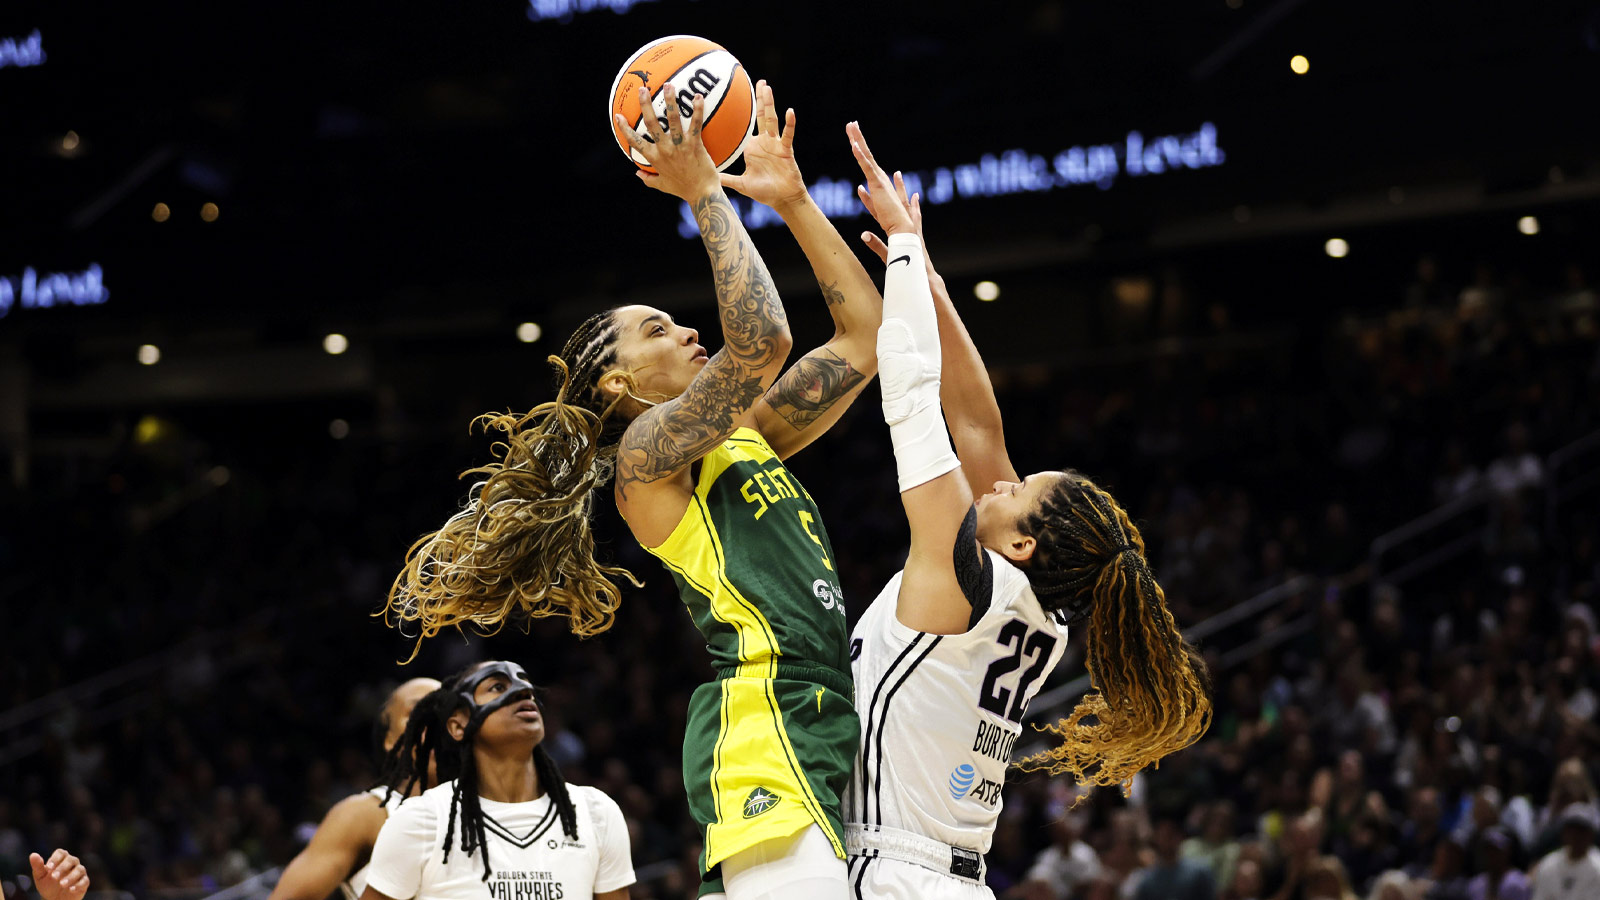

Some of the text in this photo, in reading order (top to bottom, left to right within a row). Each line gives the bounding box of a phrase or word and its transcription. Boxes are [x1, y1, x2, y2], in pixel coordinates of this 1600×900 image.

[641, 68, 721, 144] Wilo
[740, 466, 815, 521] SEAT
[978, 618, 1057, 724] 22
[973, 719, 1019, 763] BURTO
[488, 881, 564, 900] VALKYRIES
[496, 871, 553, 880] GOLDEN STATE
